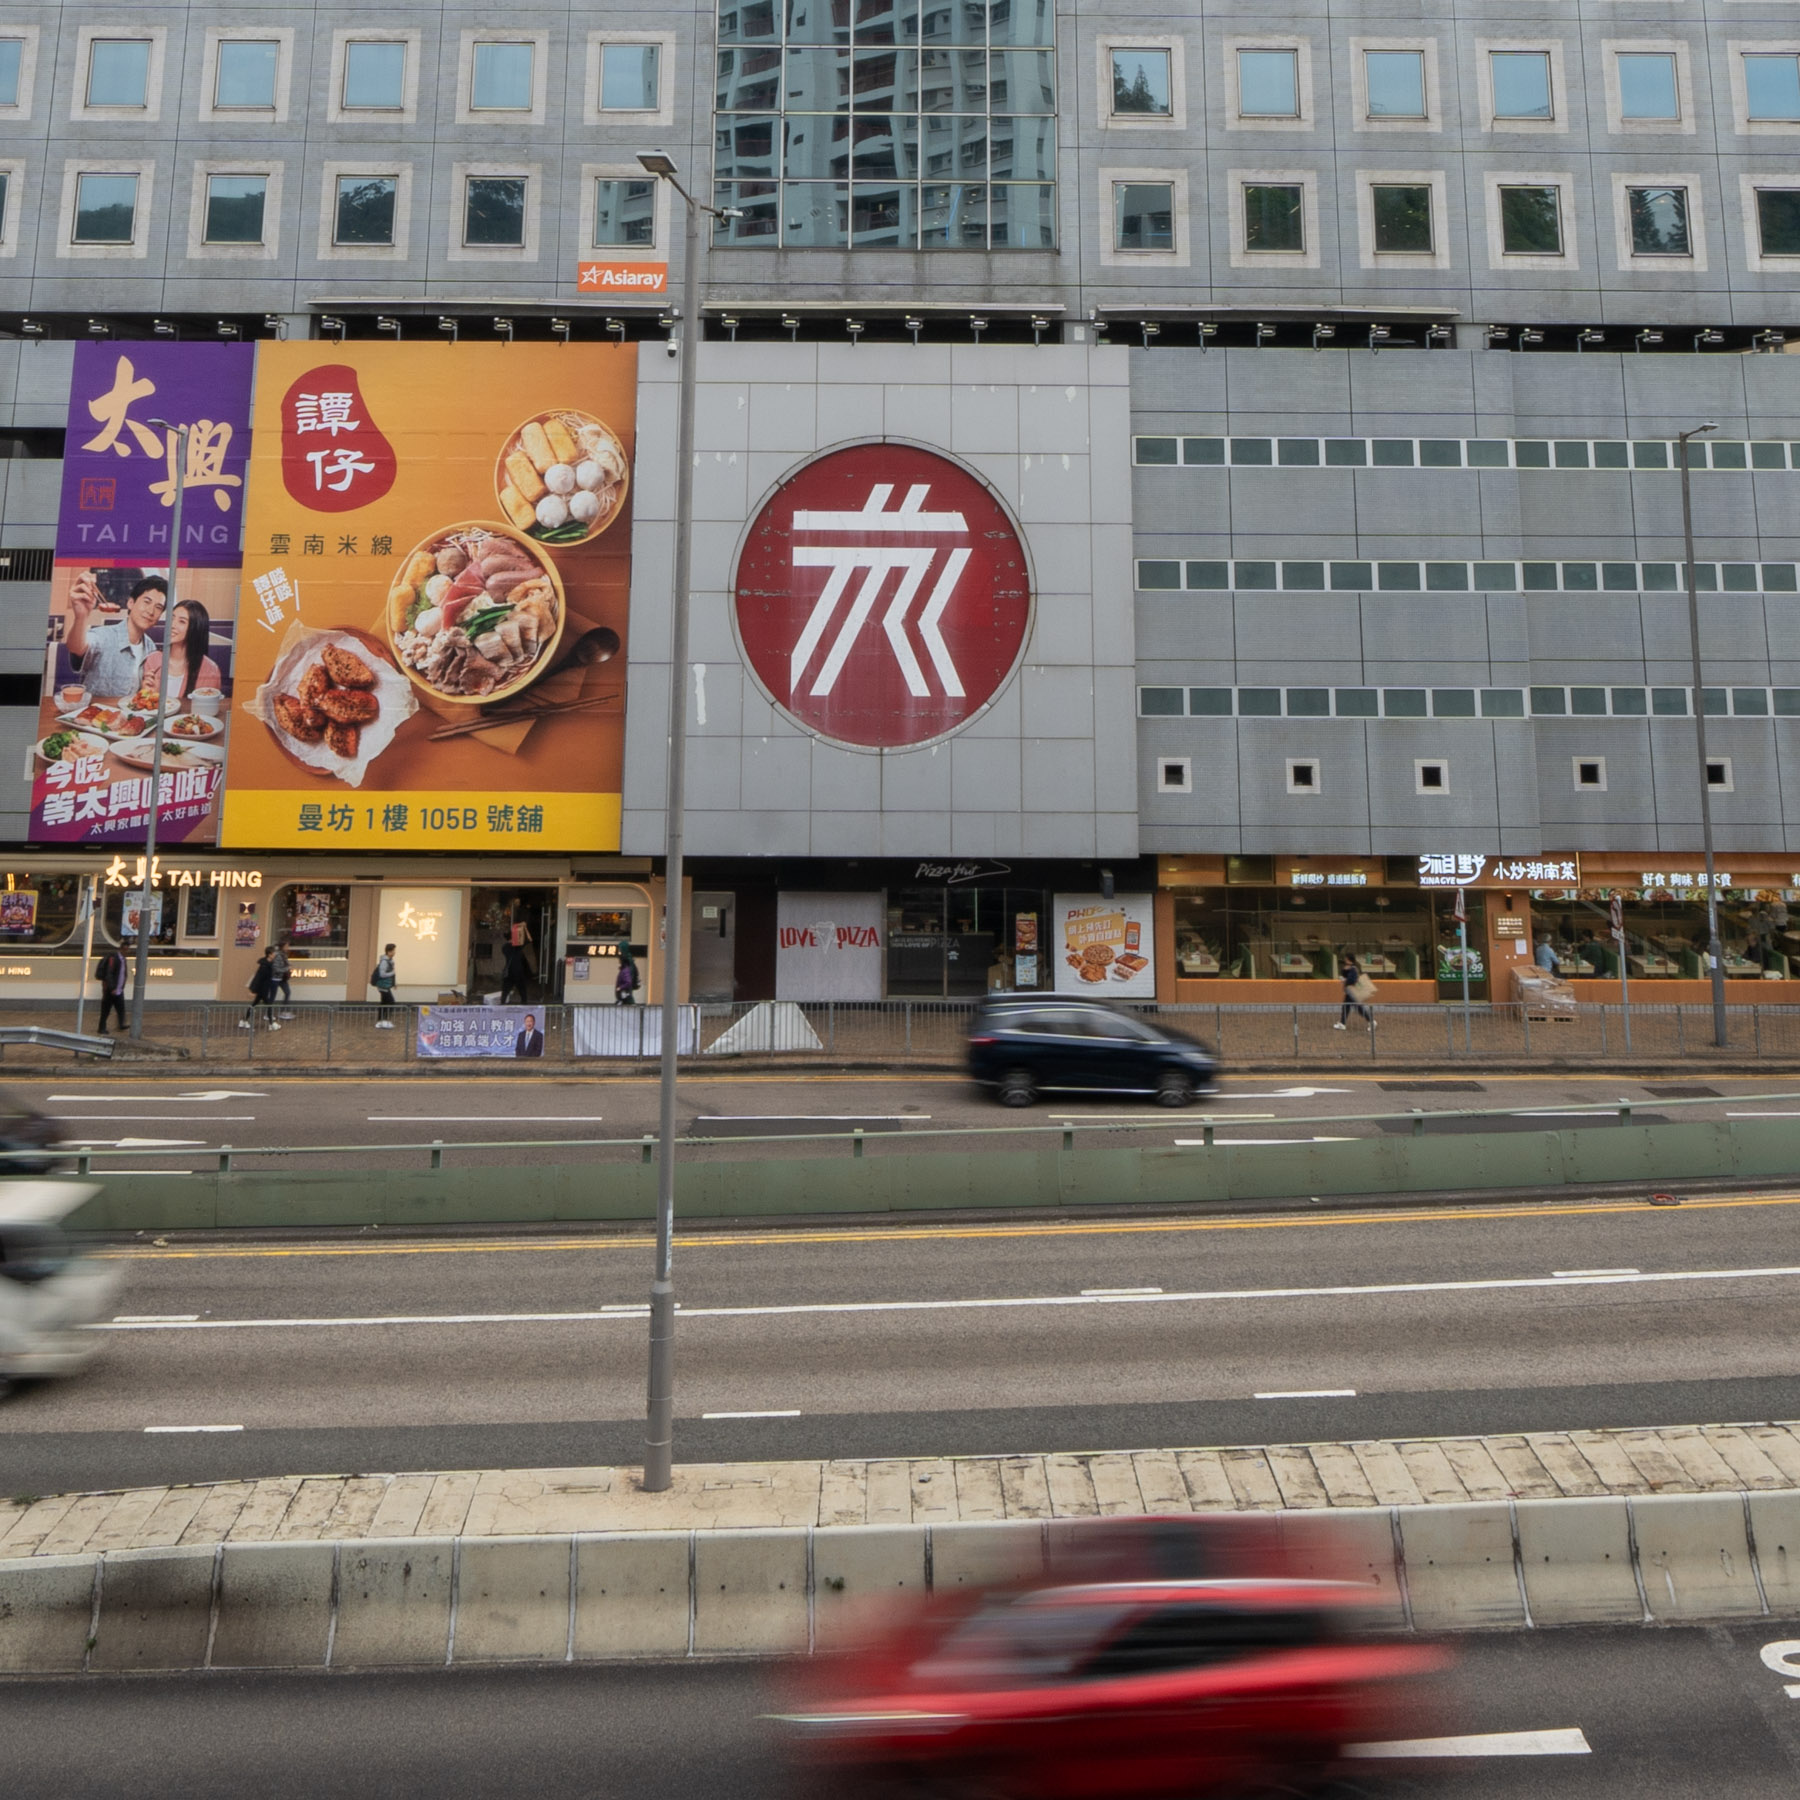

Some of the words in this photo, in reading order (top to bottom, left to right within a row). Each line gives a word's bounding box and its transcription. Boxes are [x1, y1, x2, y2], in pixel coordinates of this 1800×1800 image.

[602, 269, 664, 289] Asiaray
[81, 355, 242, 512] 太興
[295, 391, 376, 491] 譚仔
[77, 524, 129, 543] TAI
[149, 524, 229, 544] HNG
[270, 533, 393, 556] 雲南米線
[45, 754, 110, 789] 今晚
[298, 804, 355, 834] 曼坊
[382, 804, 410, 833] 樓
[420, 806, 478, 831] 105B
[167, 870, 202, 887] TAI
[210, 870, 263, 888] HING
[915, 862, 952, 878] Pizza
[1493, 861, 1577, 881] 小炒湖南菜
[1642, 872, 1665, 887] 好食
[780, 926, 816, 949] LOVE
[836, 925, 880, 950] PIZZA
[8, 967, 31, 976] HING
[149, 968, 174, 977] HING
[304, 969, 327, 977] HING
[439, 1019, 465, 1032] 加強
[490, 1019, 515, 1032] 教育
[439, 1033, 514, 1047] 培育高端人才
